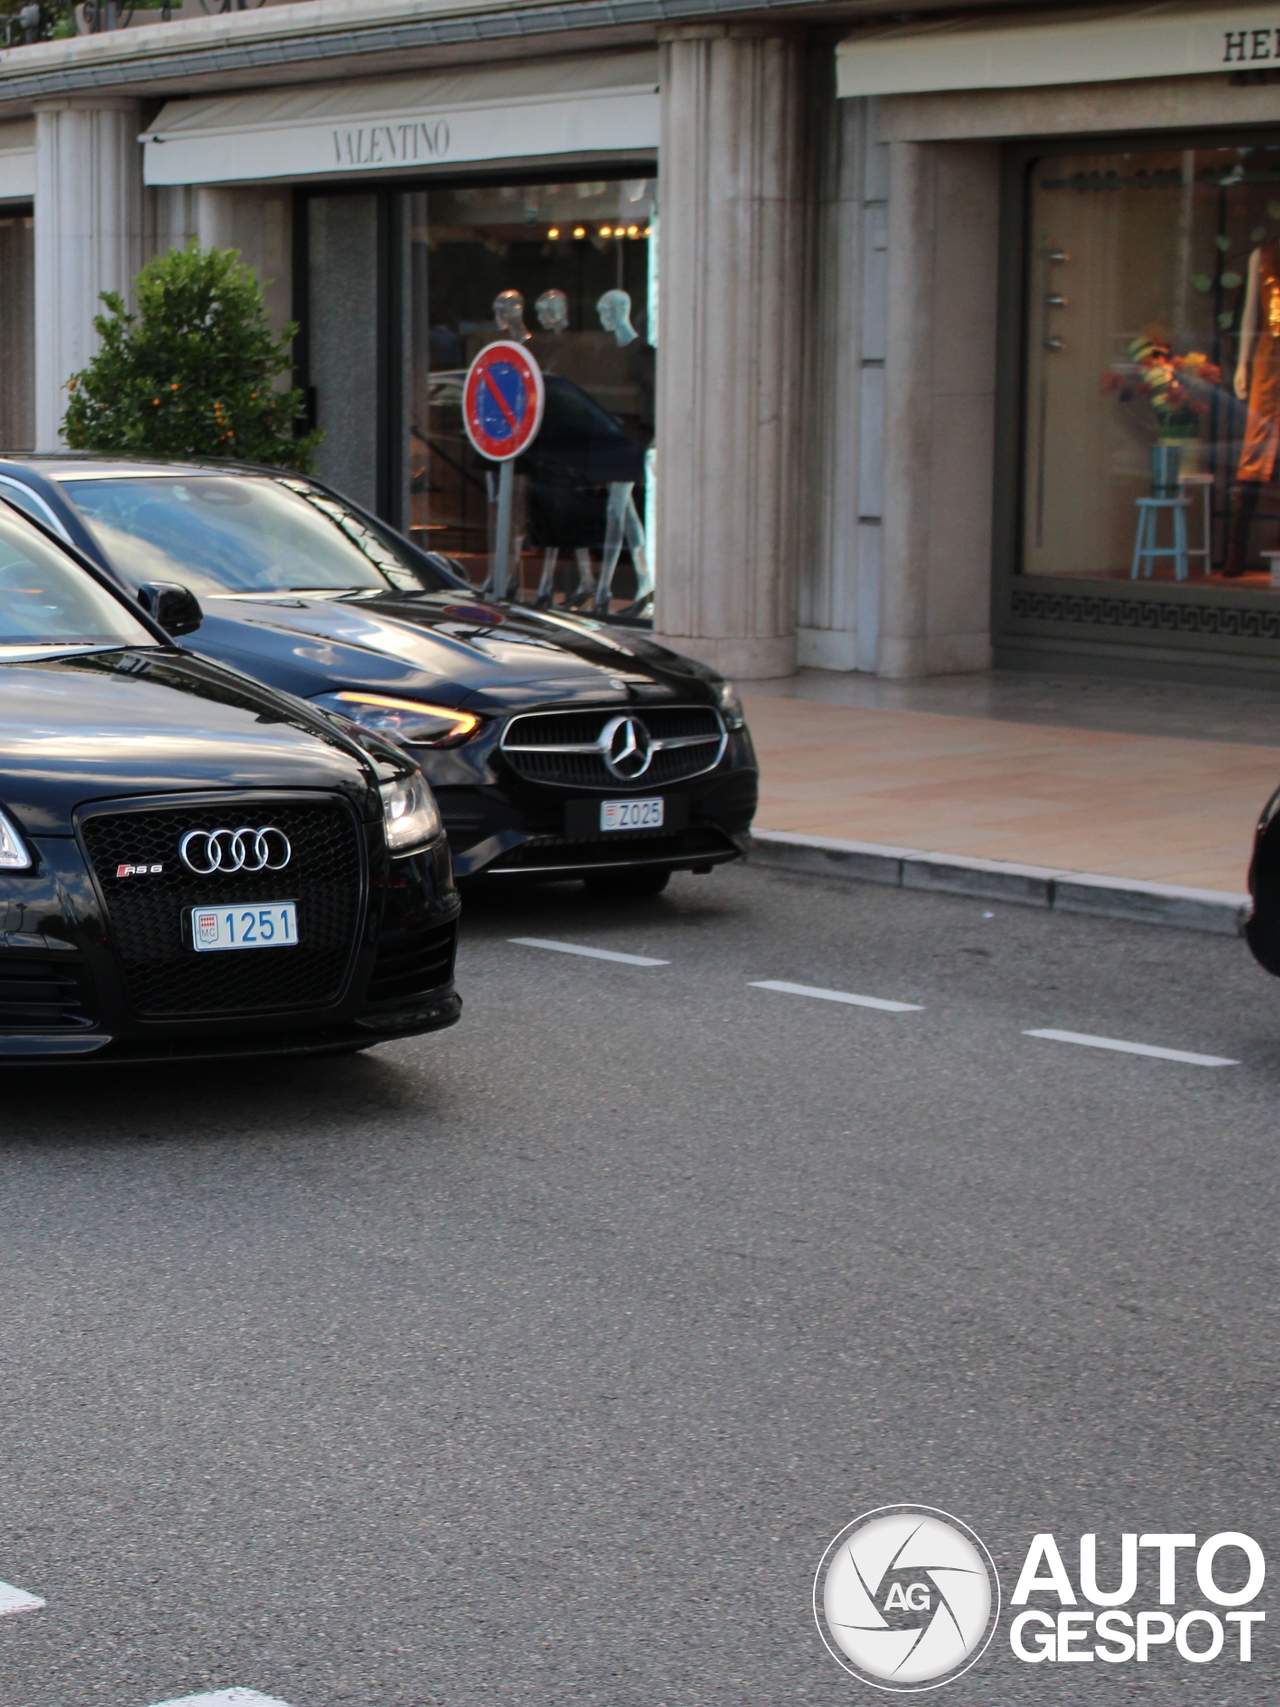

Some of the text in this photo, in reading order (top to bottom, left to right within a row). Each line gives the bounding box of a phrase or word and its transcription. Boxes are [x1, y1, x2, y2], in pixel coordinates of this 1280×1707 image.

[332, 119, 450, 165] VALENTINO
[619, 802, 661, 826] Z025
[201, 928, 216, 938] MC
[225, 909, 290, 943] 1251
